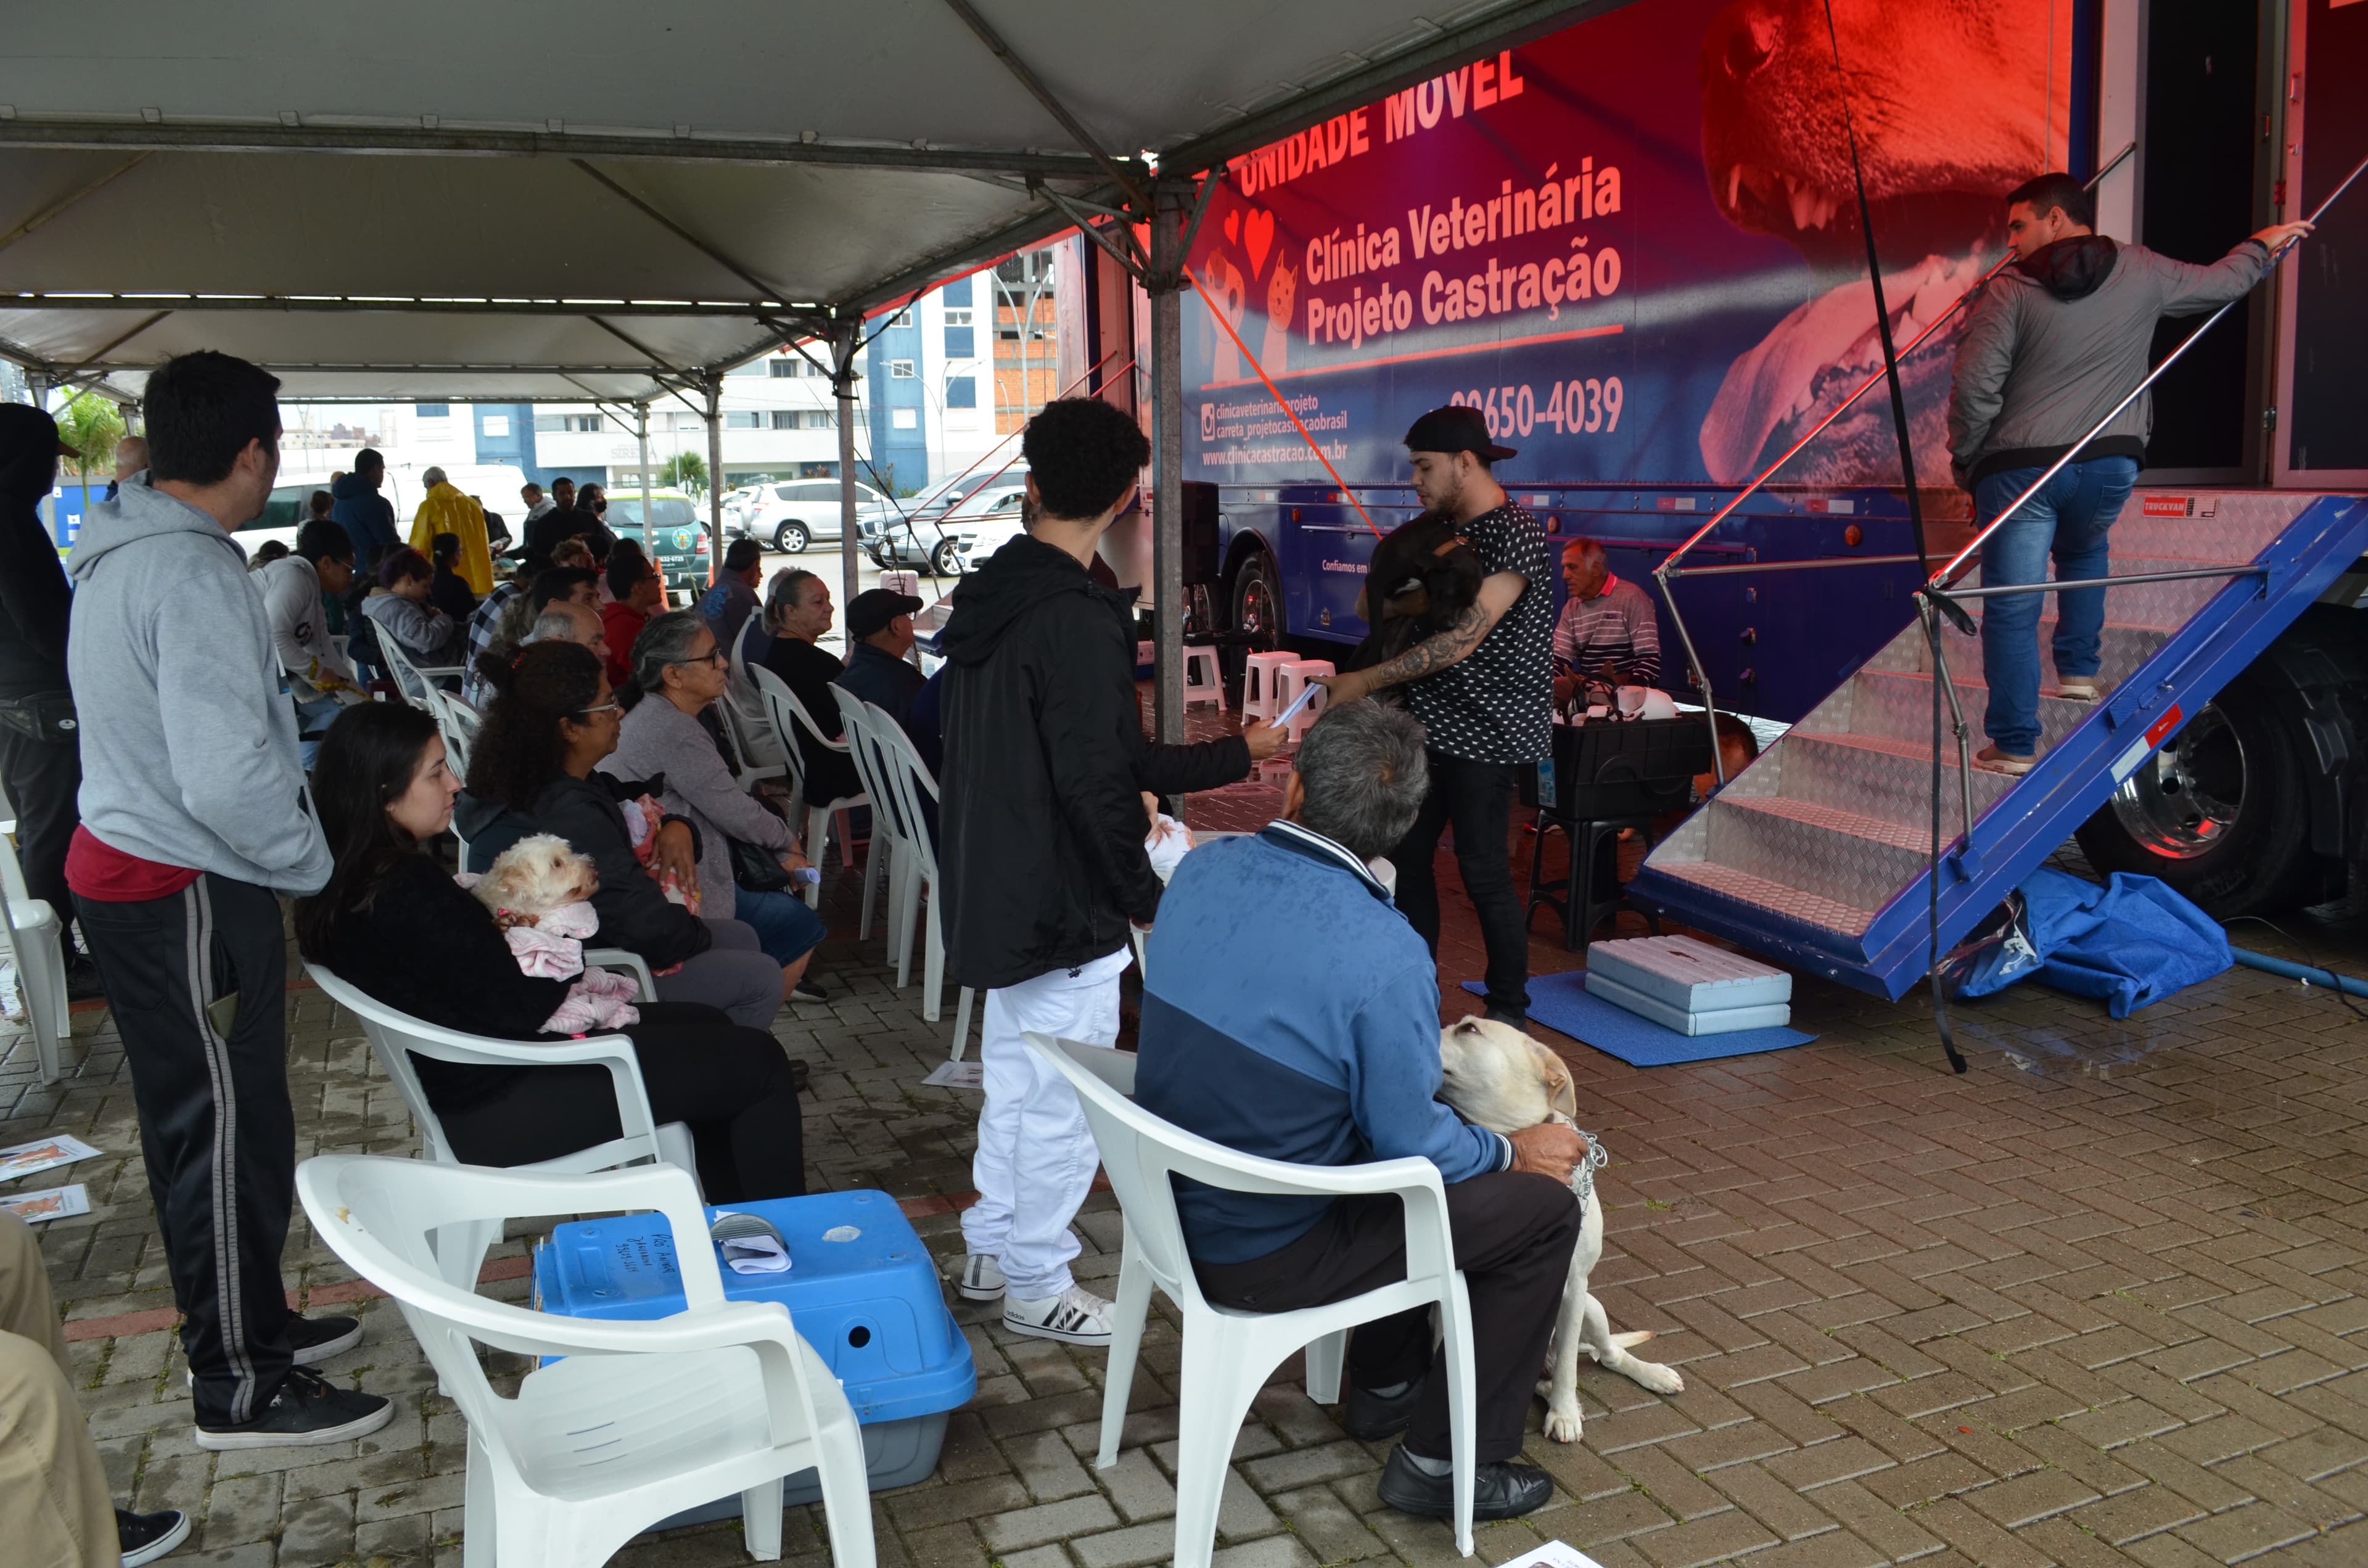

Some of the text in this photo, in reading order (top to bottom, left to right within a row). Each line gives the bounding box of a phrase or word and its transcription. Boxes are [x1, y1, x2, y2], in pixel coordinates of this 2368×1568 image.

[1306, 156, 1621, 285] Clínica Veterinária
[1308, 235, 1621, 350] Projeto Castração
[2145, 503, 2184, 511] TRUCKVAN
[1322, 559, 1355, 573] Confiamos
[1357, 564, 1367, 573] em
[1006, 1310, 1025, 1320] adidas
